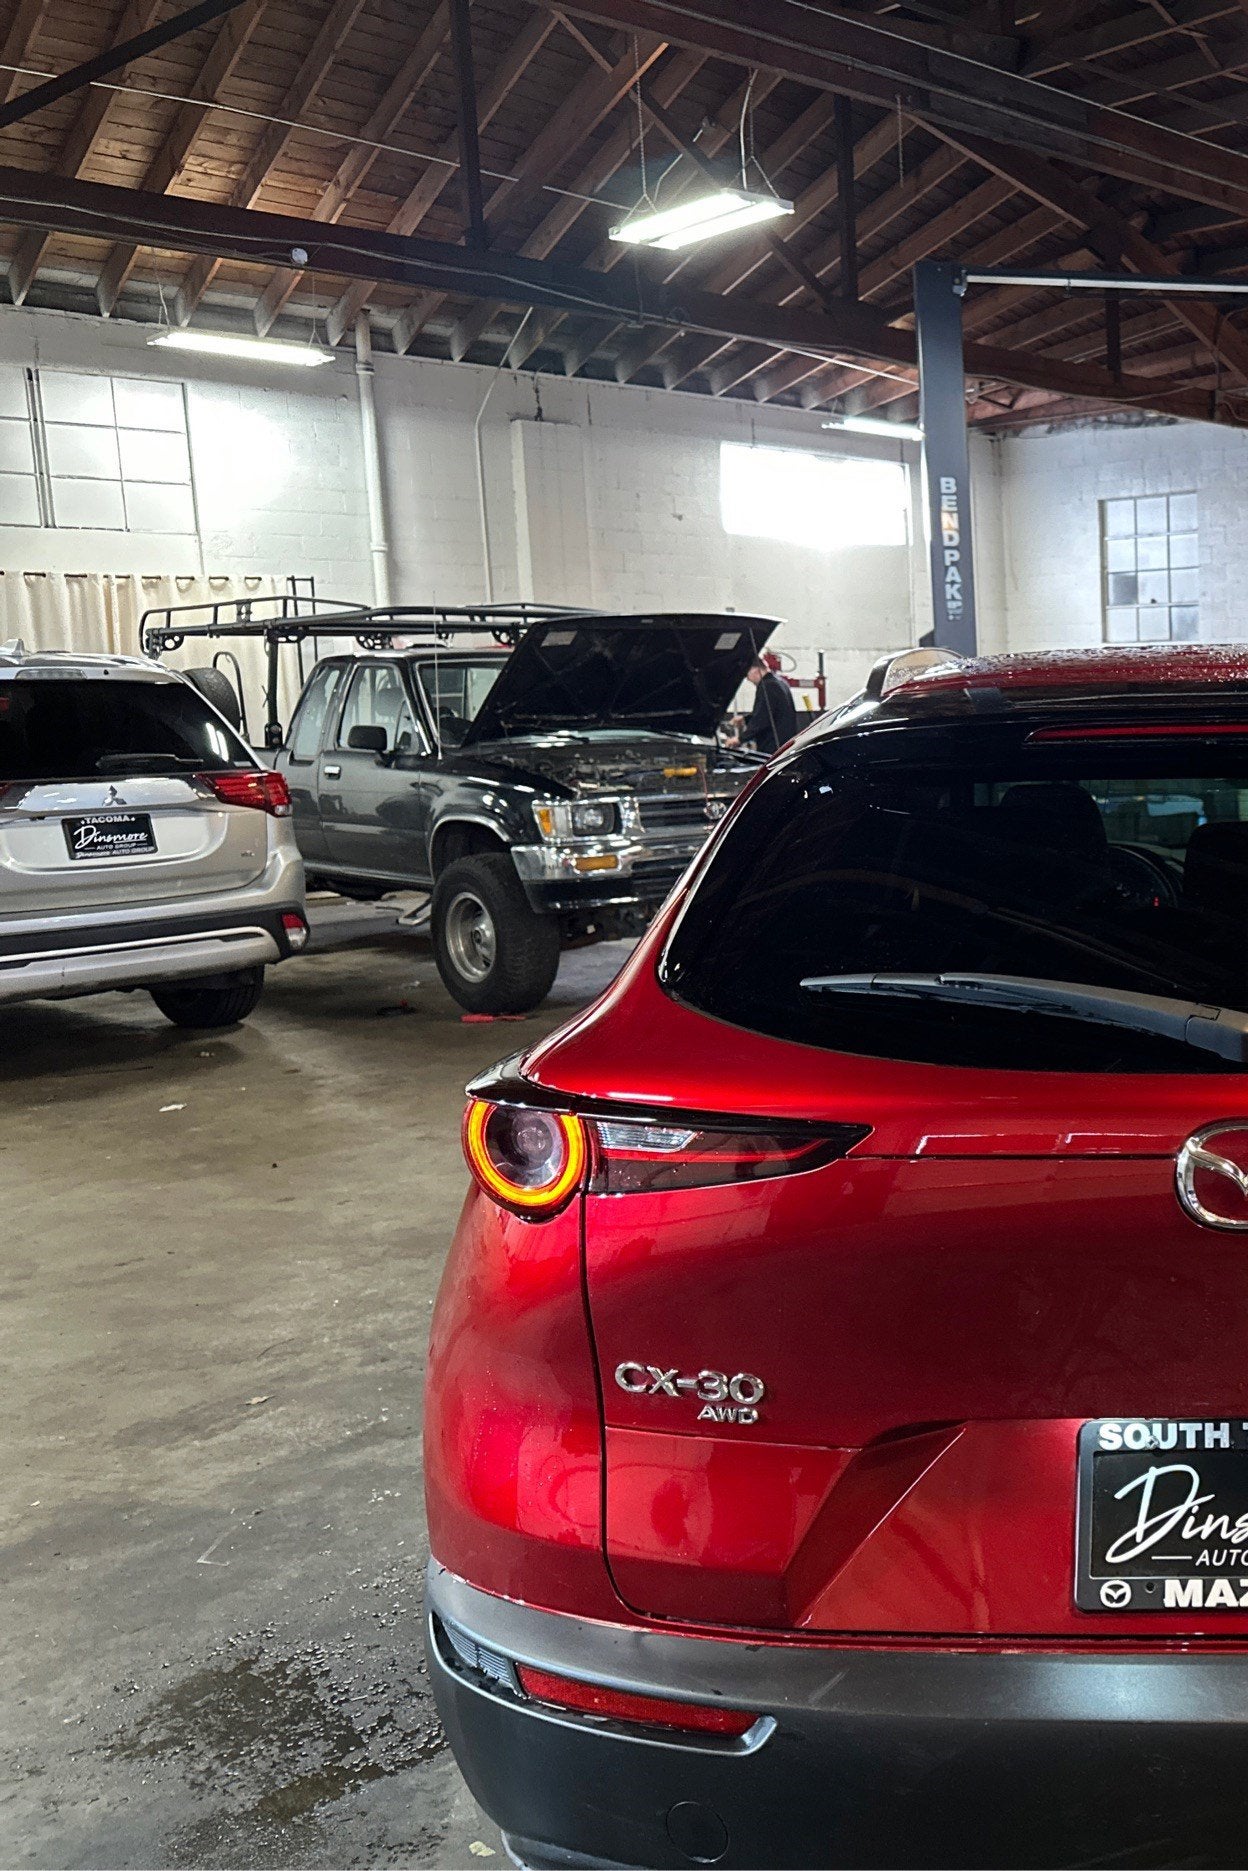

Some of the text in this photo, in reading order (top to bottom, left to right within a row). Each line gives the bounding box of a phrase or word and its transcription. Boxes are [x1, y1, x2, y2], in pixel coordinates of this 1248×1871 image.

[940, 477, 963, 600] BENDPAK
[84, 815, 130, 824] TACOMA
[73, 825, 148, 850] Dinsmore
[615, 1361, 764, 1405] CX-30
[697, 1404, 759, 1425] AWD
[1099, 1421, 1231, 1450] SOUTH
